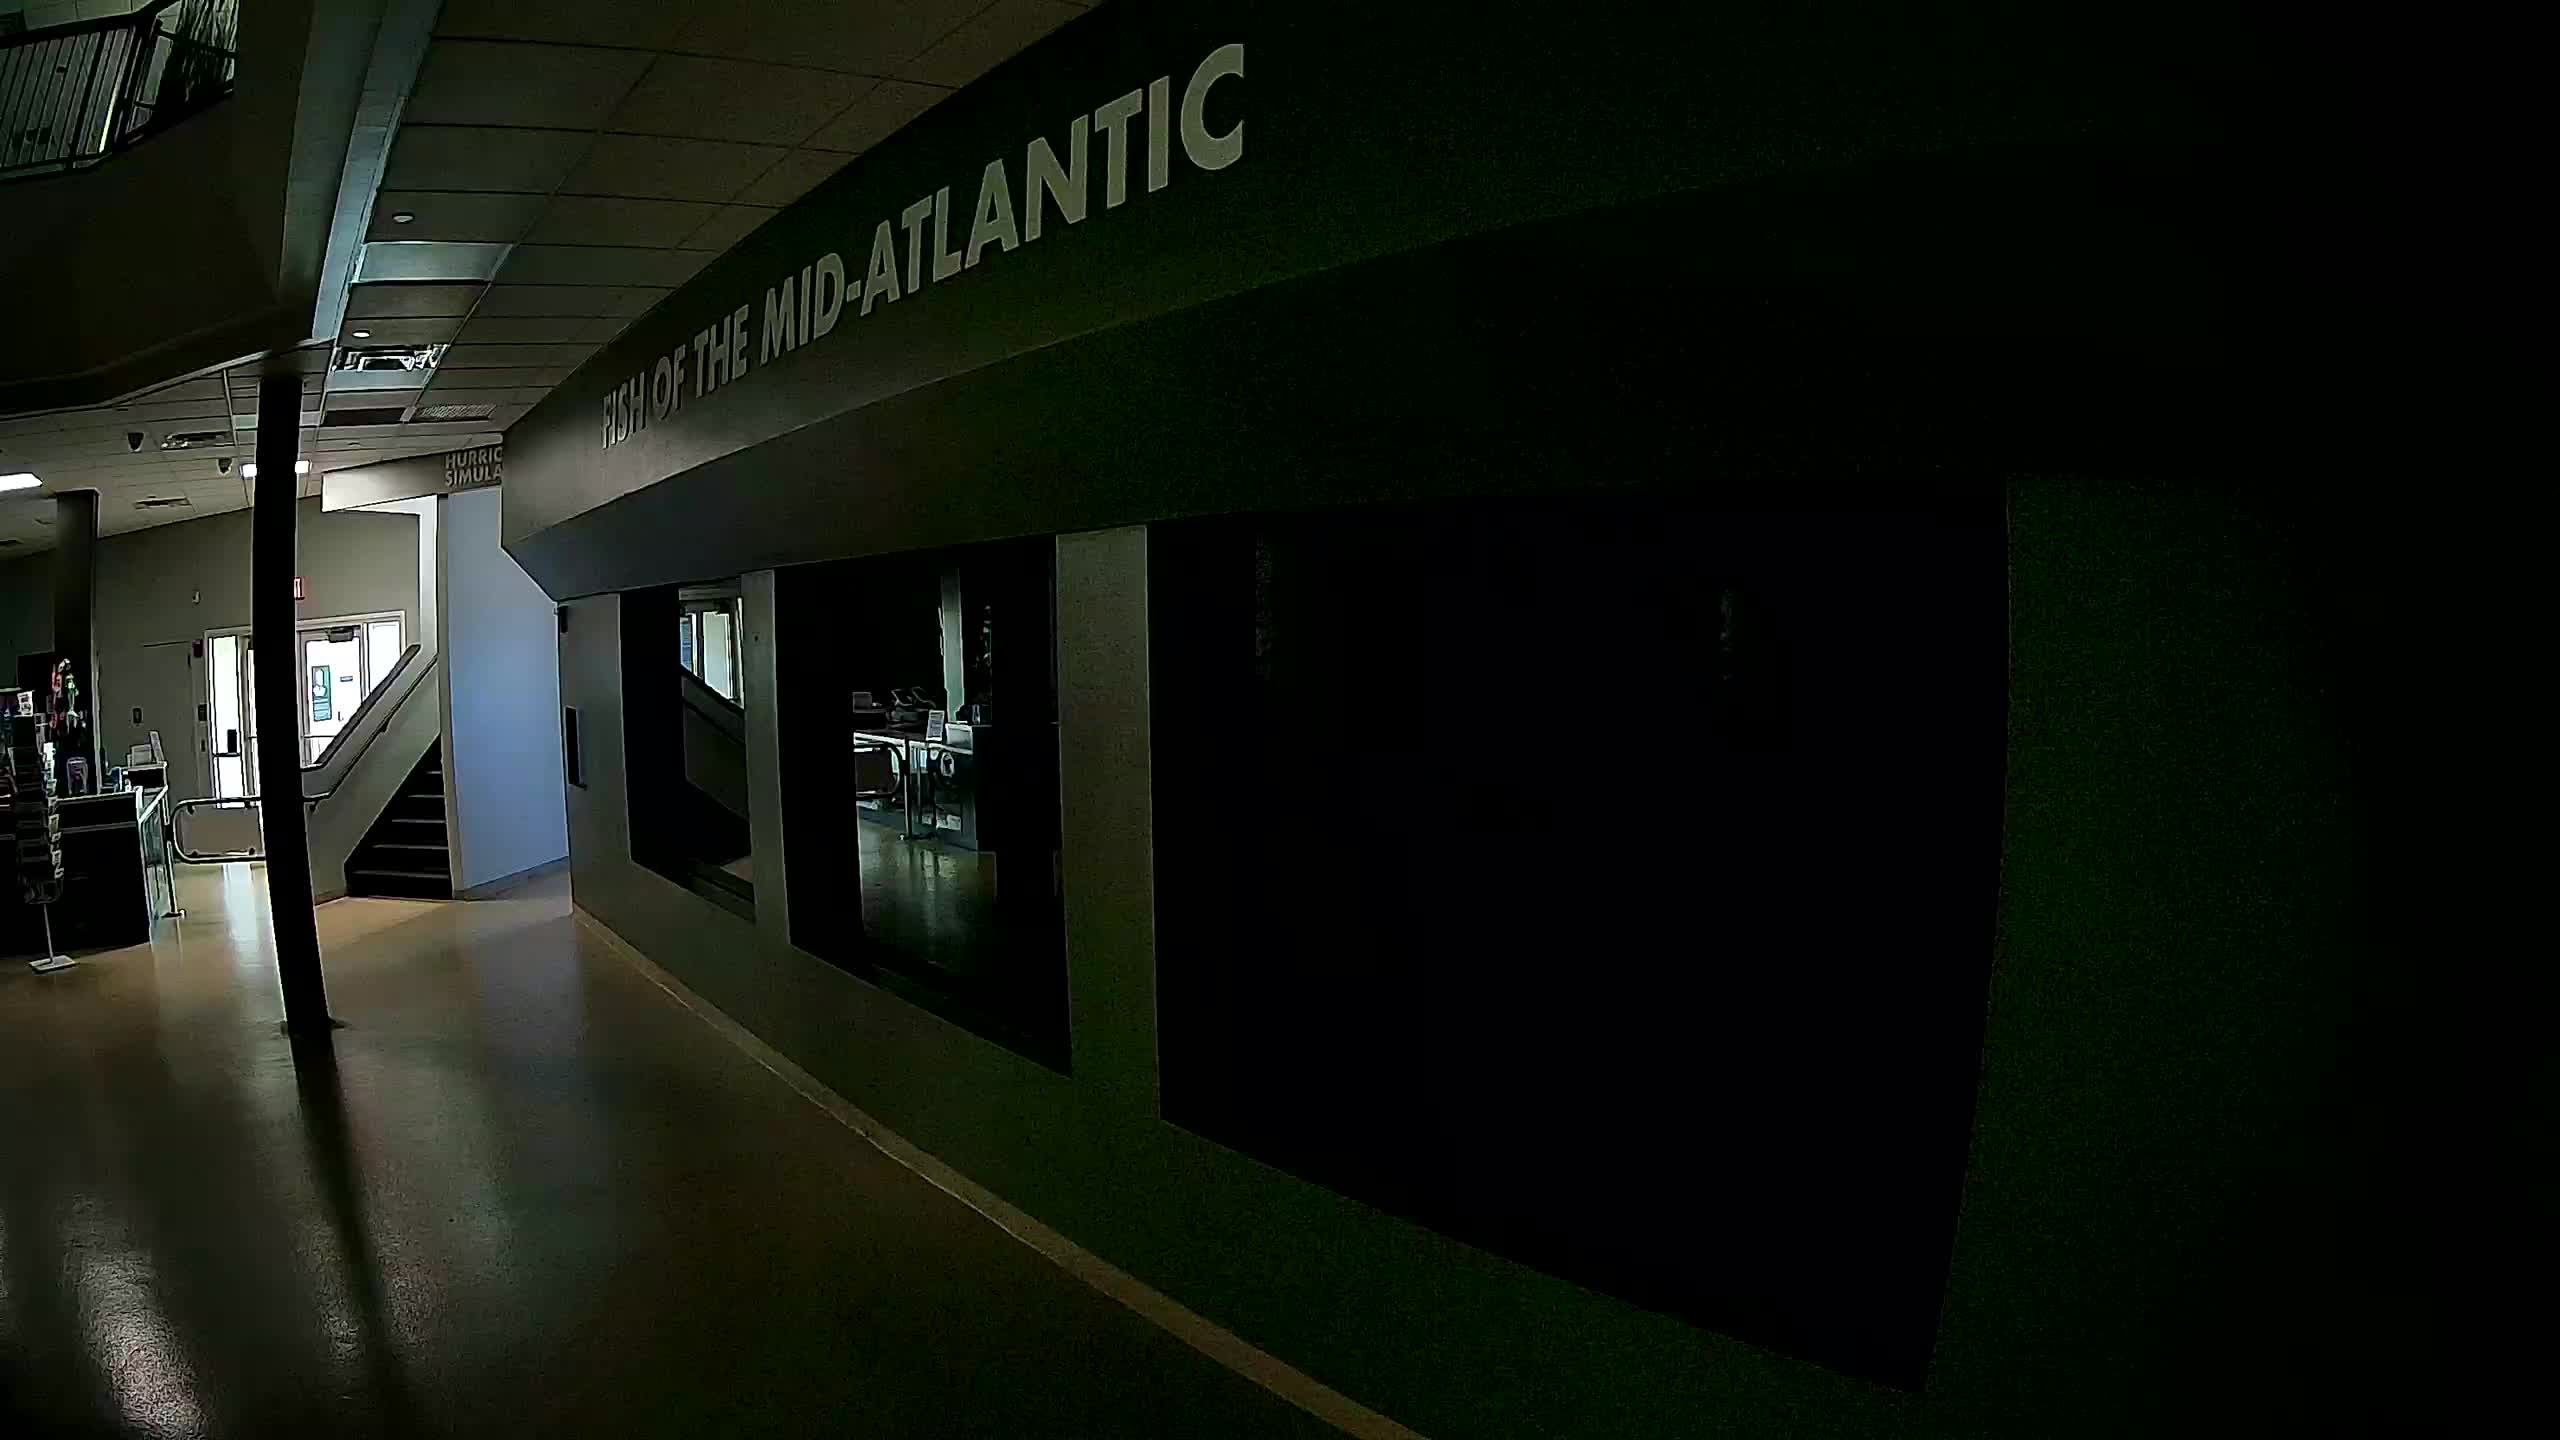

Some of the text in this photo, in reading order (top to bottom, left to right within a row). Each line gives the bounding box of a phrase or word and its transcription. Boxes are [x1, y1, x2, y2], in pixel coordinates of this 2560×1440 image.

[601, 42, 1244, 450] FISH OF THE MID-ATLANTIC
